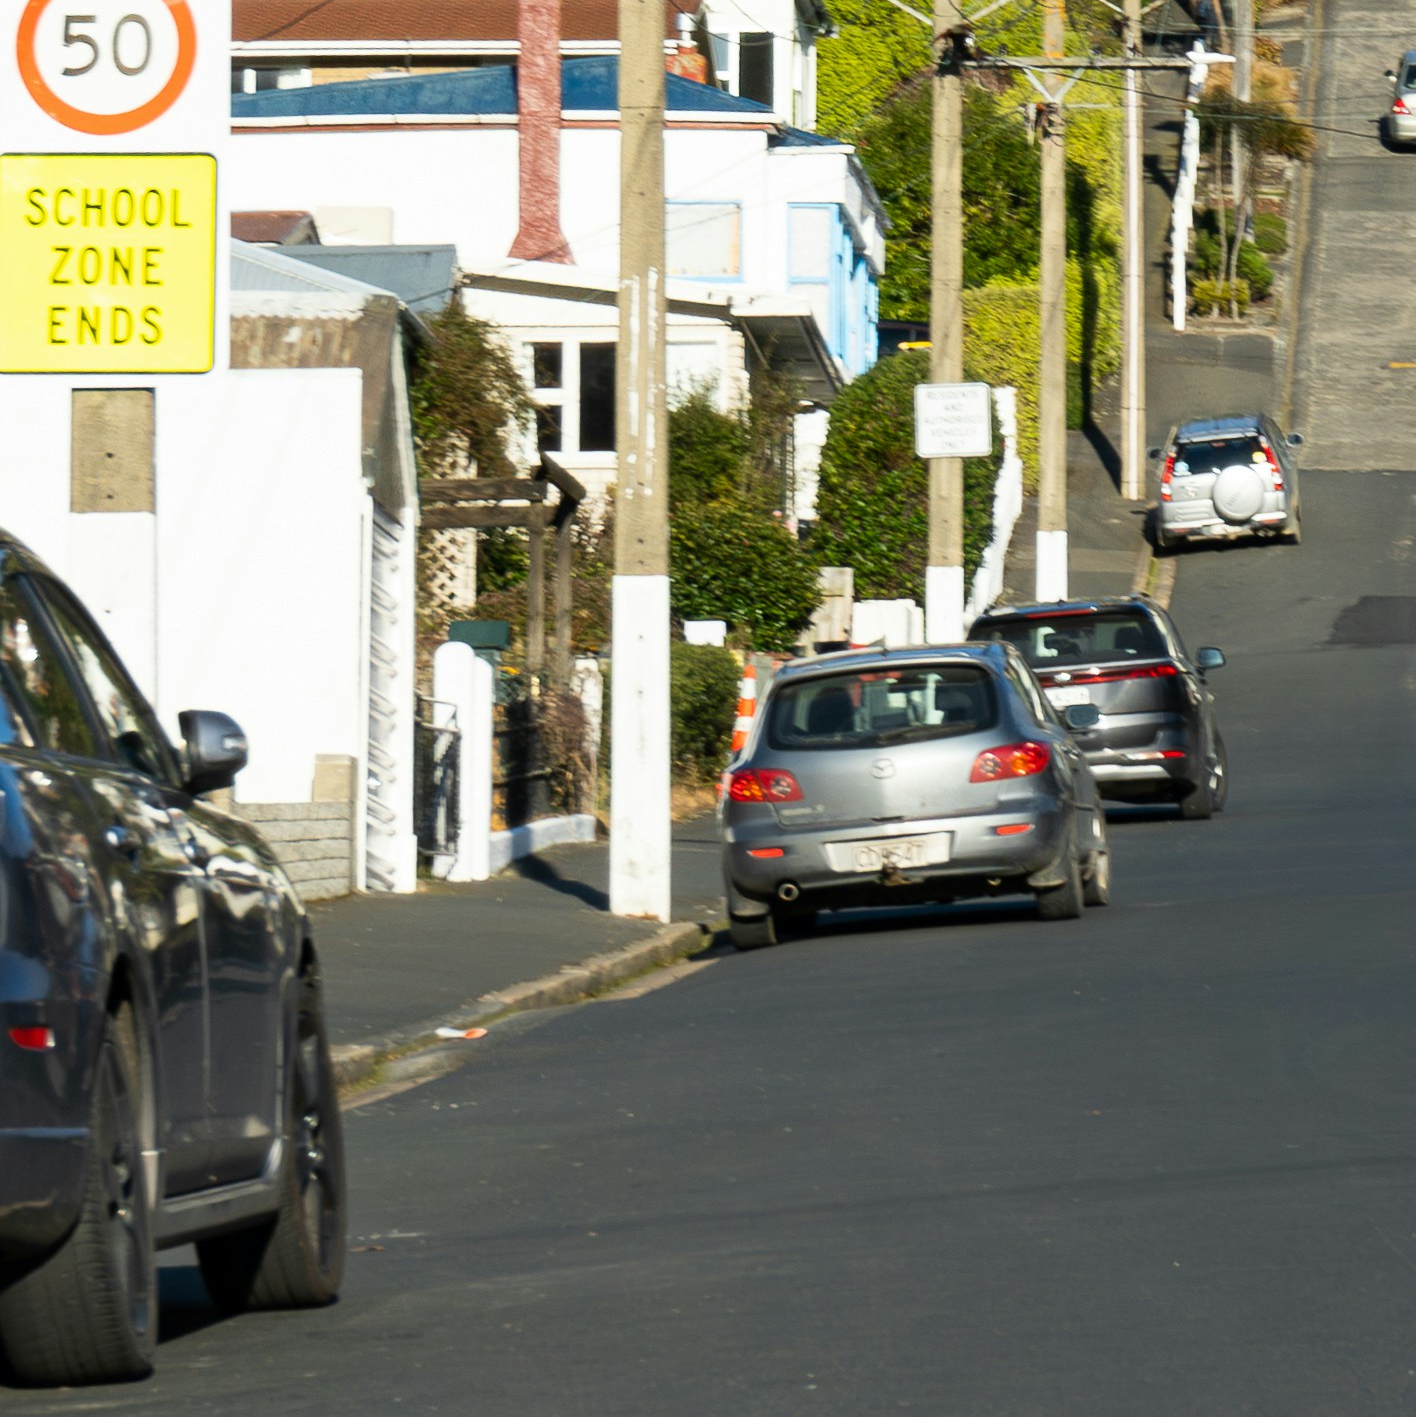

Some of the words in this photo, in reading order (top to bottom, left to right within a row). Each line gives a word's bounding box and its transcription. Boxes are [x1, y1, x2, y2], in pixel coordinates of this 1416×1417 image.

[61, 13, 153, 77] 50
[26, 188, 191, 227] SCHOOL
[50, 247, 164, 286] ZONE
[50, 306, 162, 345] ENDS
